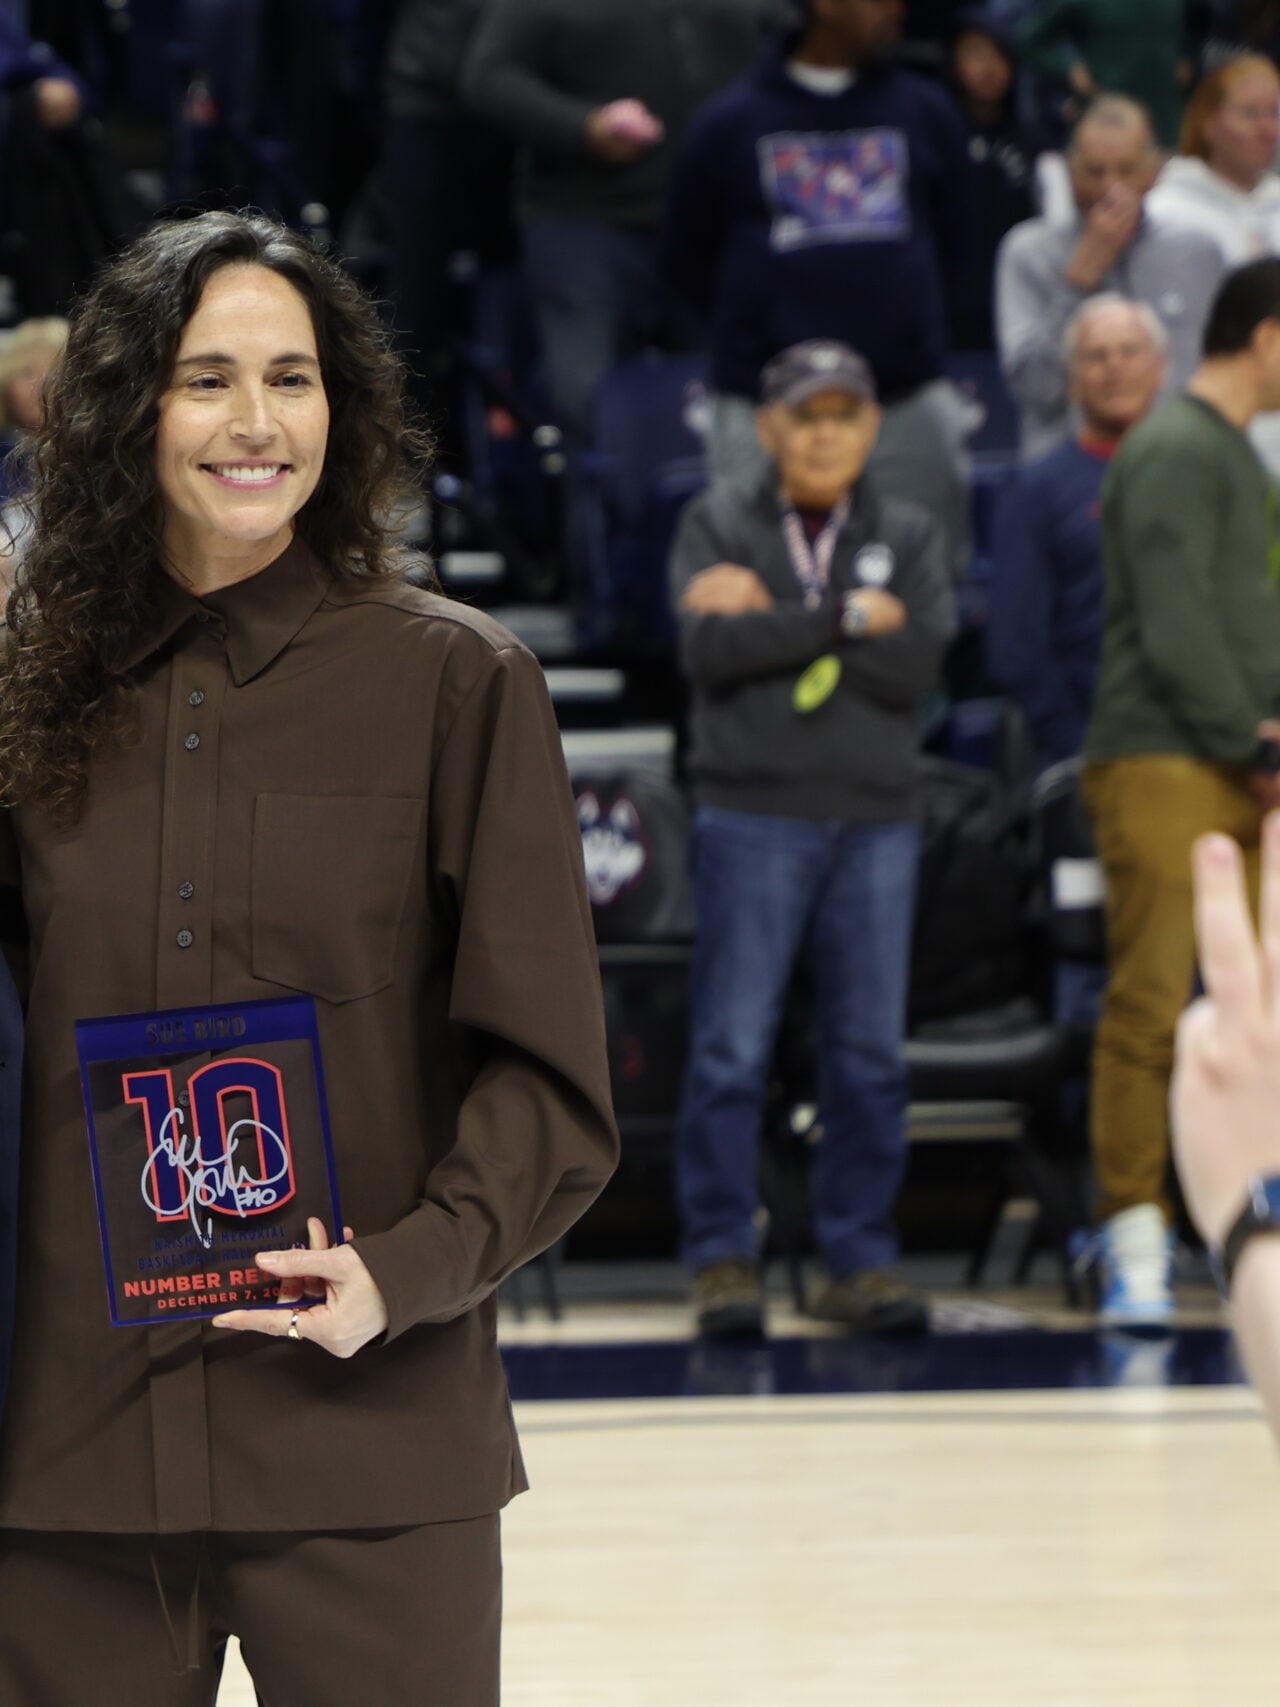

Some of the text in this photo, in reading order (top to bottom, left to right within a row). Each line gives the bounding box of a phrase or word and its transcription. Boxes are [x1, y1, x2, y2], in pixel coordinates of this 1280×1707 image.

[146, 1014, 247, 1046] SUE BIRD
[122, 1057, 296, 1222] 10
[123, 1272, 222, 1298] NUMBER
[157, 1291, 238, 1310] DECEMBER
